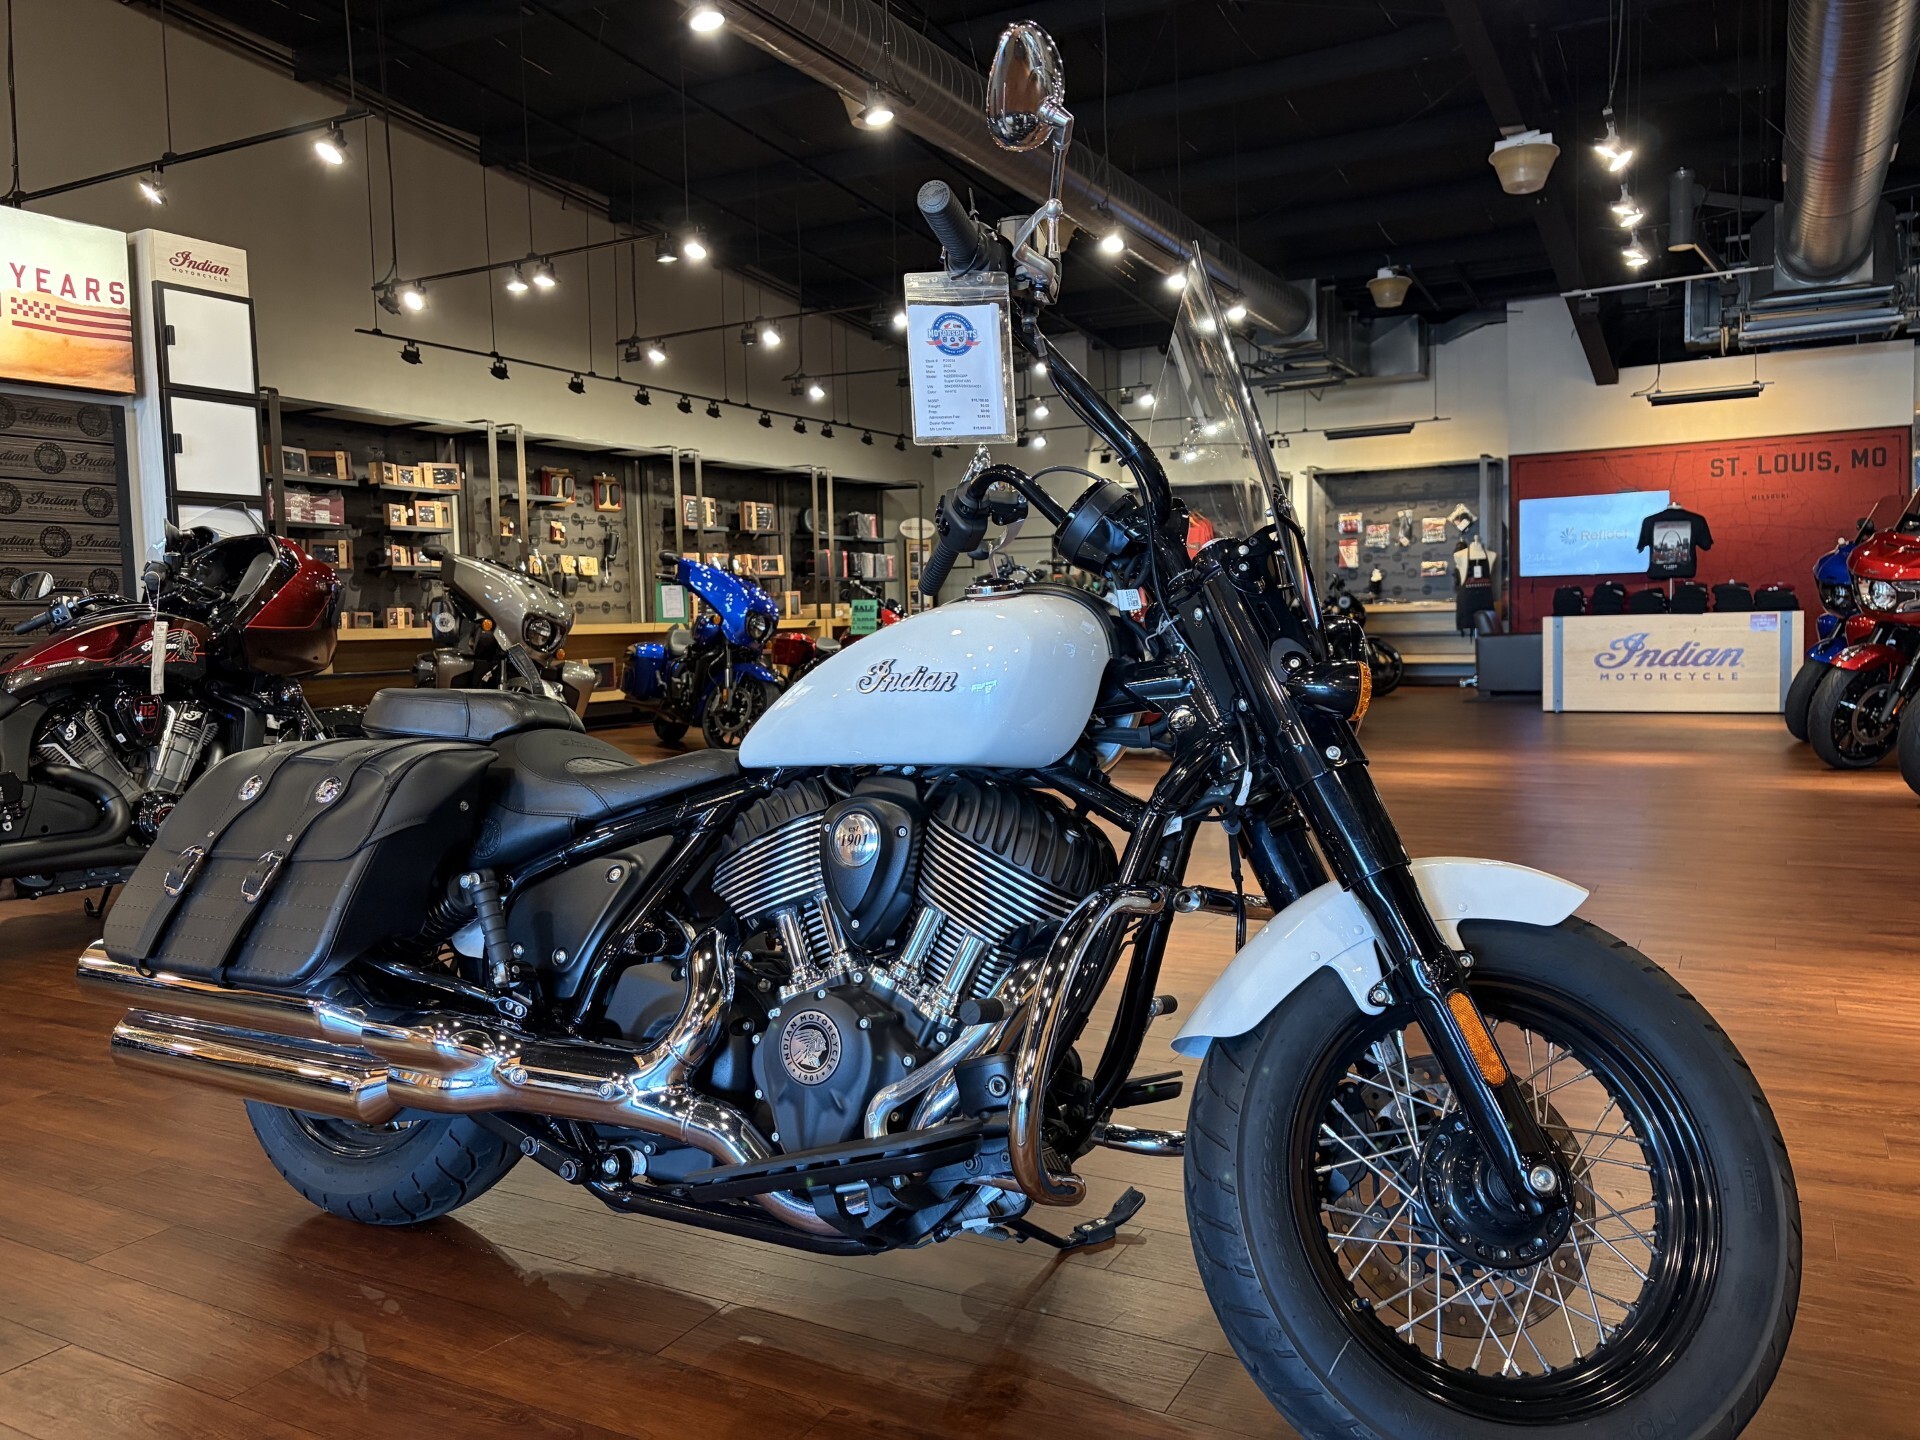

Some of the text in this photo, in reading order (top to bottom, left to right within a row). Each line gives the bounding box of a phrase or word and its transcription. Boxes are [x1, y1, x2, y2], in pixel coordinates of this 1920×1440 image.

[169, 250, 230, 277] Indian
[9, 261, 125, 305] YEARS
[172, 267, 229, 283] MOTORCYCLE
[928, 329, 977, 339] MOTORSPORTS
[20, 406, 72, 425] Indian
[0, 450, 29, 463] dian
[1710, 446, 1887, 477] ST. LOUIS, MO
[26, 490, 78, 507] Indian
[55, 577, 83, 588] dian
[853, 605, 875, 613] SALE
[1594, 632, 1745, 670] Indian
[856, 659, 959, 695] Indian
[1600, 672, 1739, 682] MOTORCYCLE
[138, 705, 157, 717] 112
[840, 833, 869, 848] 1901
[783, 1013, 838, 1071] INDIAN MOTORCYCLE
[798, 1072, 820, 1082] 1901
